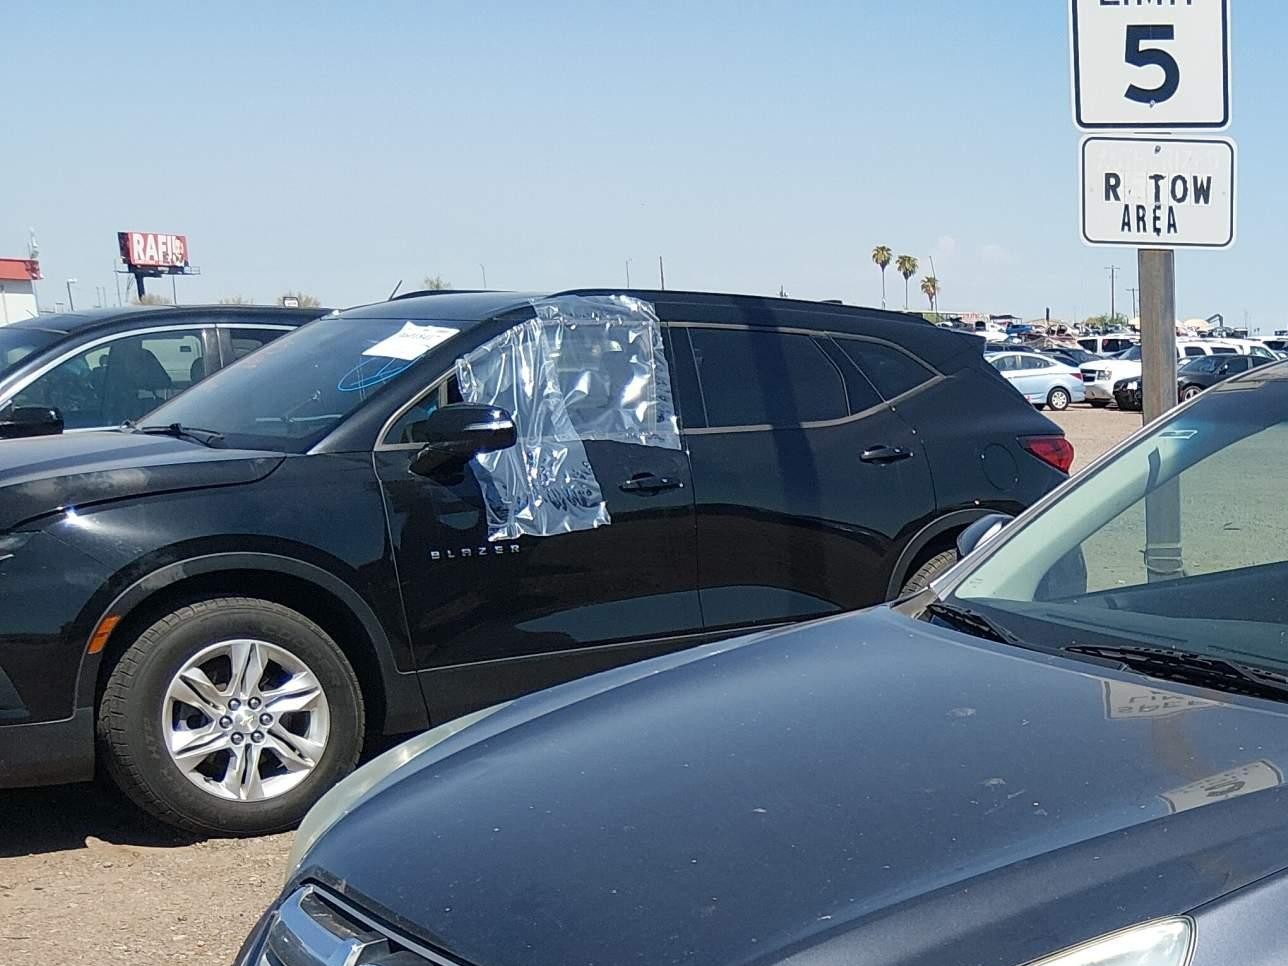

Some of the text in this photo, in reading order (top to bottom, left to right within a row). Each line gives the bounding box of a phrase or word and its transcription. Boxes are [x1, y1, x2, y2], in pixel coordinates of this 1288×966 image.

[1124, 24, 1180, 104] 5
[1149, 174, 1212, 205] TOW
[1121, 203, 1178, 235] AREA
[430, 544, 520, 560] BLAZER
